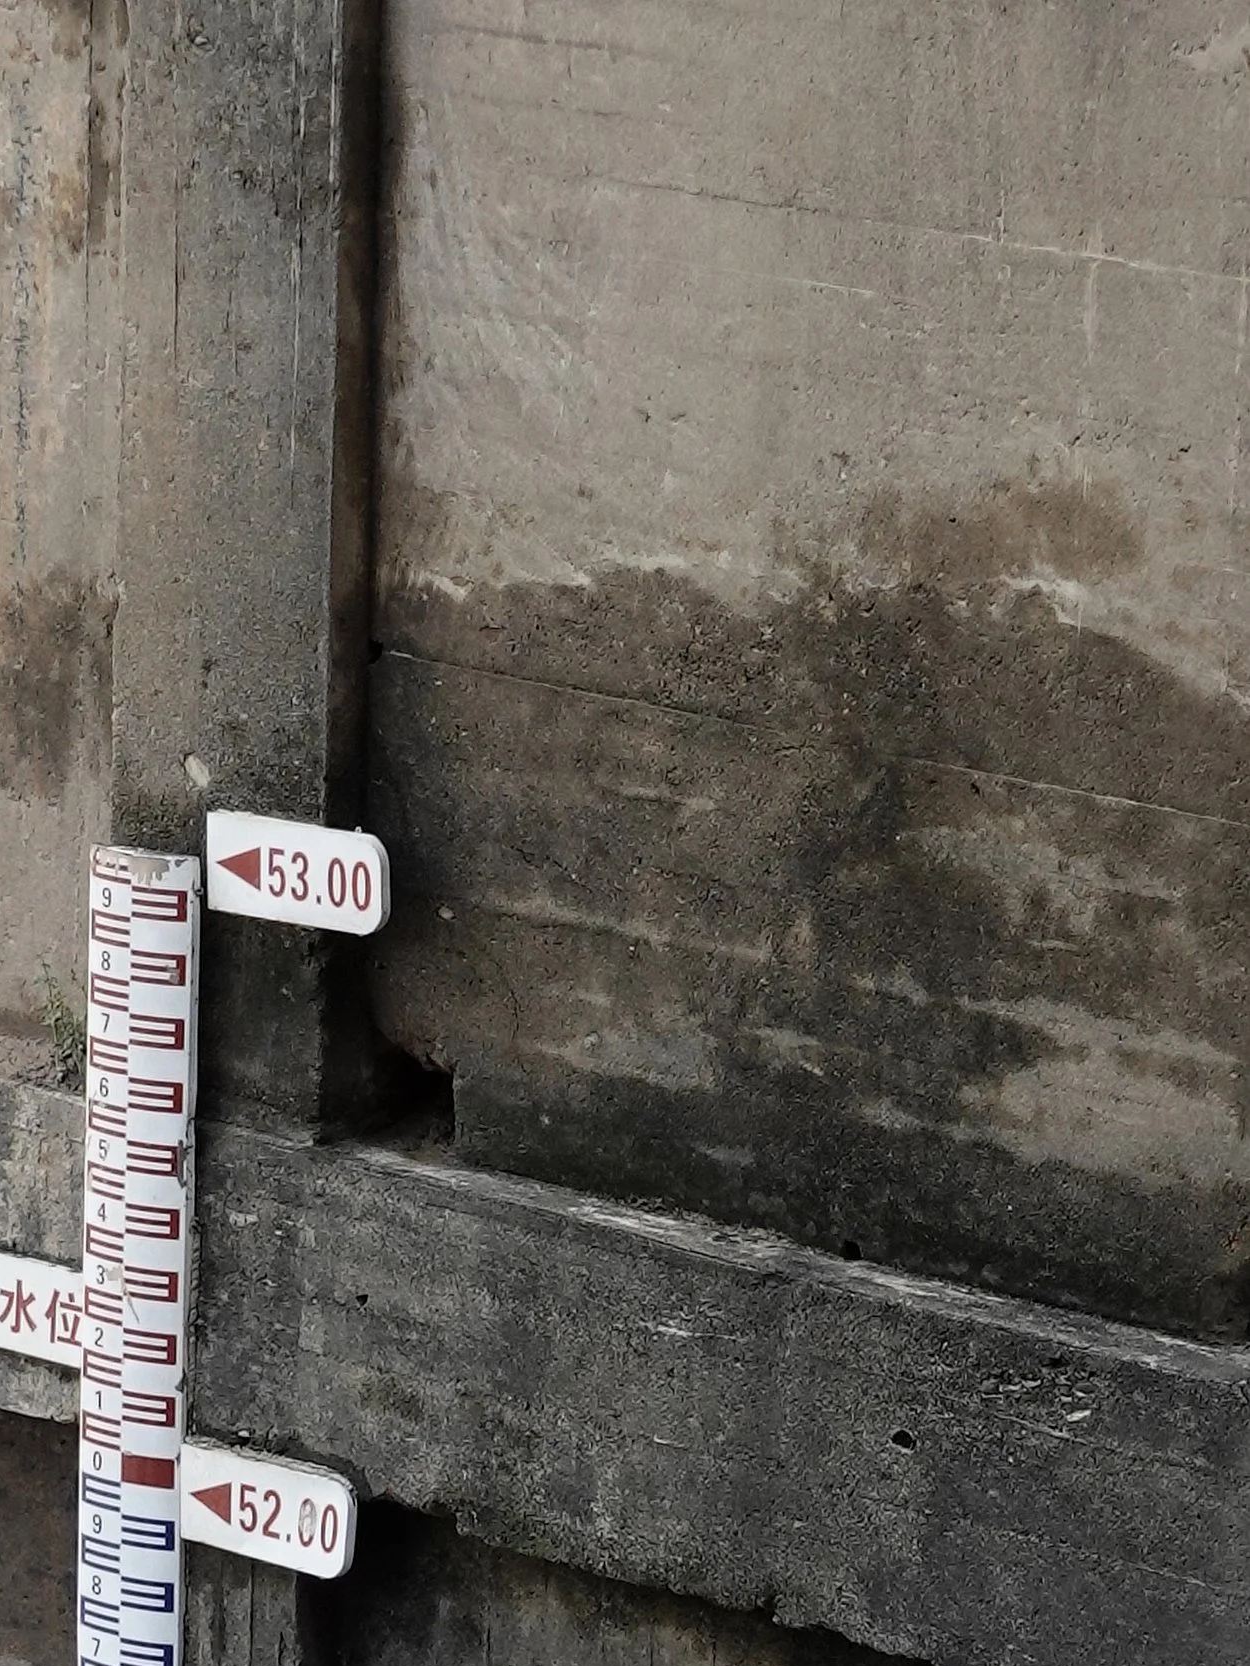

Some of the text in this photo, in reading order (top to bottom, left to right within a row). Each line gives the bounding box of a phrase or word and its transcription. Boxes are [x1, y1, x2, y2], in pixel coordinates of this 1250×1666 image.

[268, 847, 372, 911] 53.00
[102, 887, 112, 908] 9
[101, 950, 111, 971] 8
[101, 1012, 110, 1033] 7
[99, 1077, 109, 1097] 6
[98, 1139, 109, 1161] 5
[97, 1202, 107, 1222] 4
[96, 1264, 105, 1285] 3
[94, 1327, 104, 1348] 2
[95, 1390, 102, 1410] 1
[93, 1451, 102, 1471] 0
[92, 1514, 102, 1534] 9
[239, 1483, 339, 1554] 52.00
[92, 1575, 101, 1595] 8
[91, 1637, 100, 1656] 7
